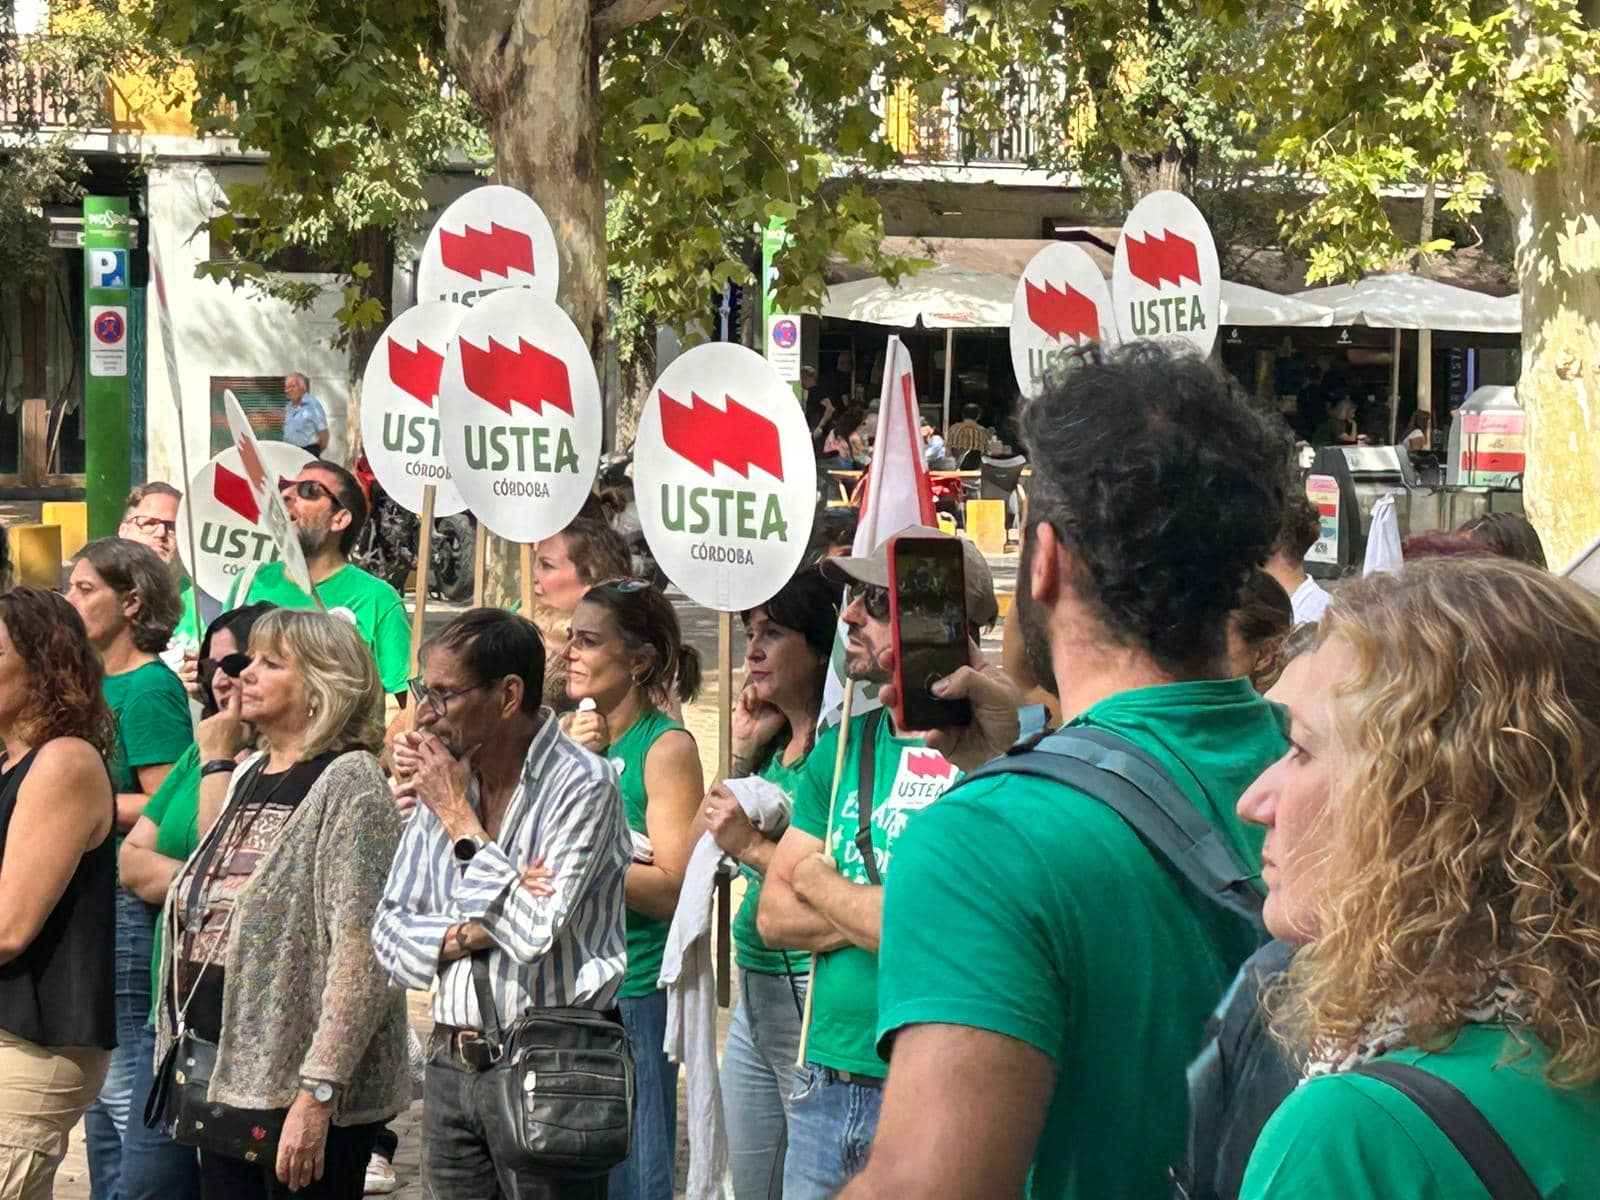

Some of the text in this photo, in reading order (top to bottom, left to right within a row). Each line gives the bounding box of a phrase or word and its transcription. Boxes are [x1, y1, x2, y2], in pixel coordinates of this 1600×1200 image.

[91, 251, 118, 288] P
[1130, 294, 1206, 336] USTEA
[382, 412, 441, 457] UST
[464, 425, 580, 474] USTEA
[405, 461, 451, 480] CÓRDOB
[493, 478, 551, 498] CÓRDOBA
[661, 483, 788, 542] USTEA
[200, 522, 281, 562] UST
[690, 542, 754, 565] CÓRDOBA
